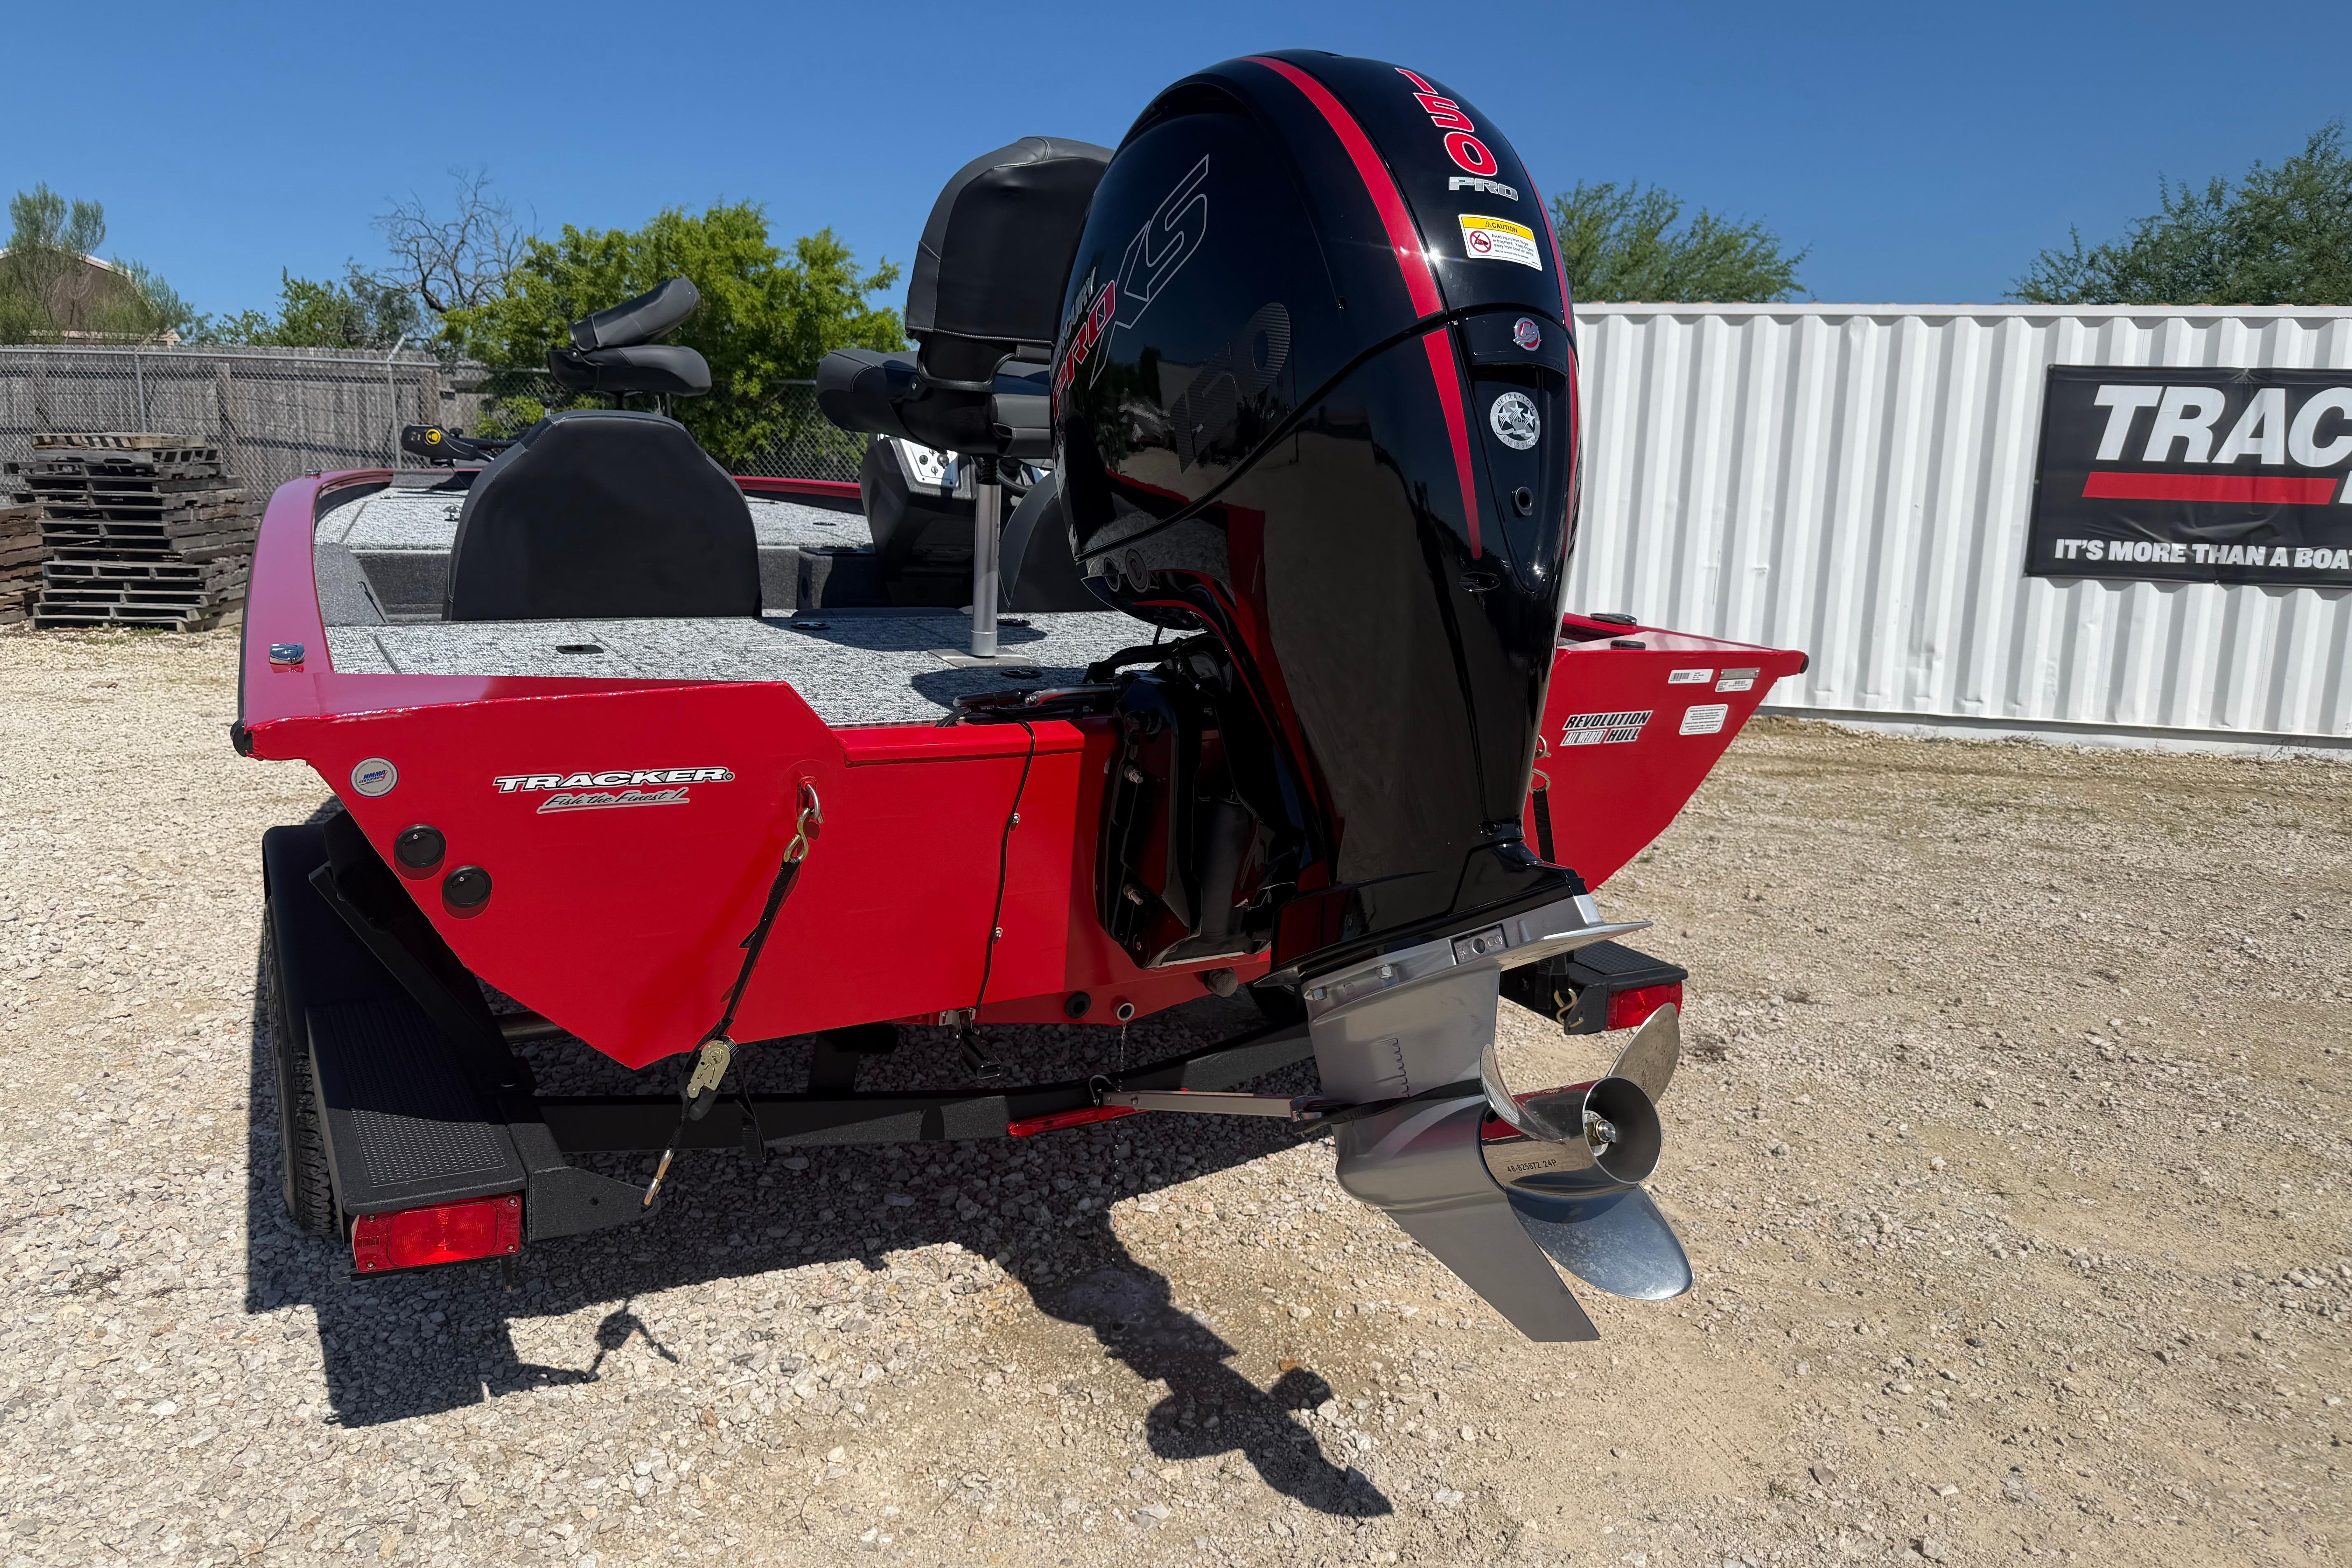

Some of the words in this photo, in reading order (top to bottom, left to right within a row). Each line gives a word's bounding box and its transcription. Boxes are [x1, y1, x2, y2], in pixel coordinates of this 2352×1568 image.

[1395, 68, 1498, 177] 150
[1449, 177, 1518, 201] PRO
[1492, 222, 1518, 233] CAUTION
[1086, 153, 1209, 390] XS
[1053, 280, 1115, 427] PRO
[2055, 539, 2104, 561] IT'S
[2108, 541, 2186, 564] MORE
[2192, 544, 2266, 566] THAN
[2269, 547, 2289, 567] A
[2294, 547, 2352, 570] BOA
[1564, 712, 1651, 728] REVOLUTION
[1606, 728, 1640, 742] HULL
[495, 768, 728, 792] TRACKER
[545, 794, 584, 807] Fish
[585, 793, 613, 805] the
[1507, 1162, 1542, 1172] 48-825872
[1543, 1159, 1556, 1167] 24P
